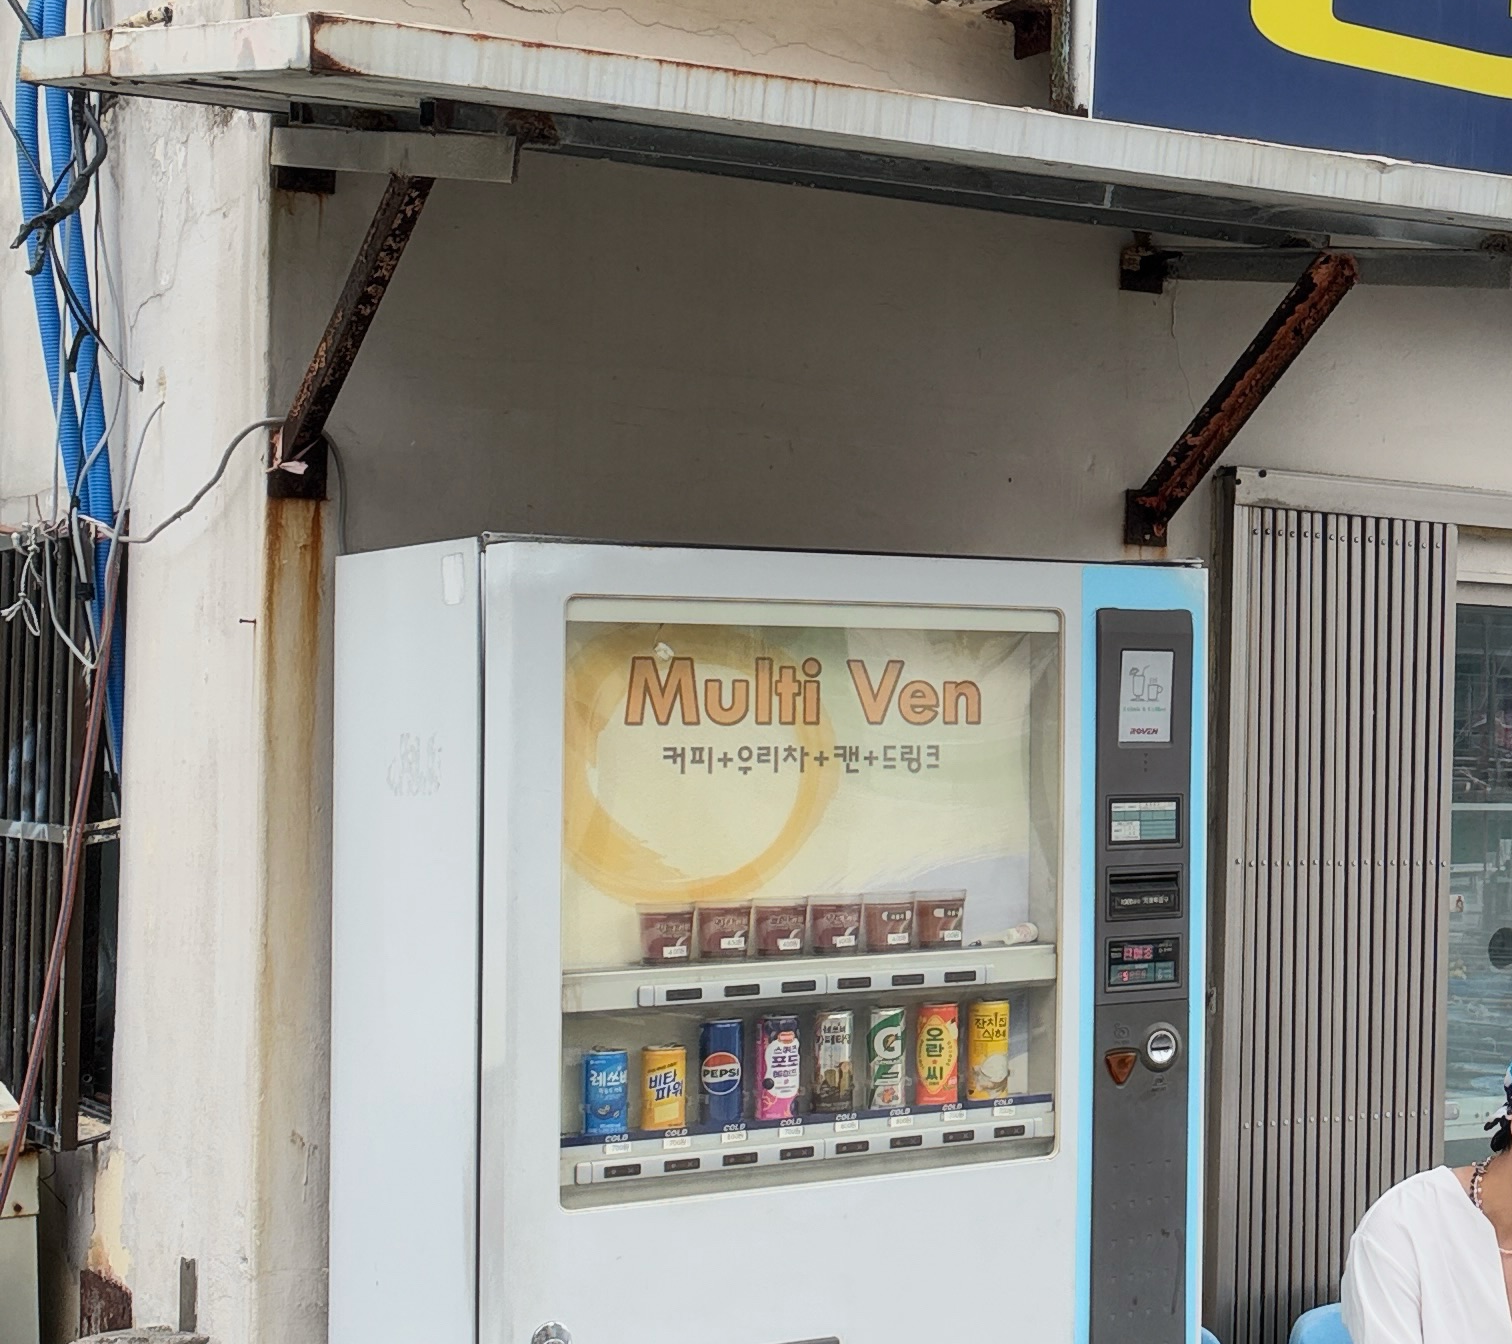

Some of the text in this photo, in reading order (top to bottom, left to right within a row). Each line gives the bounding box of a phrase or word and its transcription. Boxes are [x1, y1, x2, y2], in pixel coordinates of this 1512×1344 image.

[624, 656, 982, 726] Multi Ven
[702, 1068, 740, 1078] PEPSI
[649, 1069, 677, 1089] 비타
[993, 1098, 1014, 1107] COLD
[889, 1108, 911, 1116] COLD
[942, 1103, 963, 1112] COLD
[835, 1112, 858, 1121] COLD
[779, 1118, 803, 1127] COLD
[723, 1123, 746, 1132] COLD
[664, 1129, 688, 1137] COLD
[605, 1134, 629, 1142] COLD
